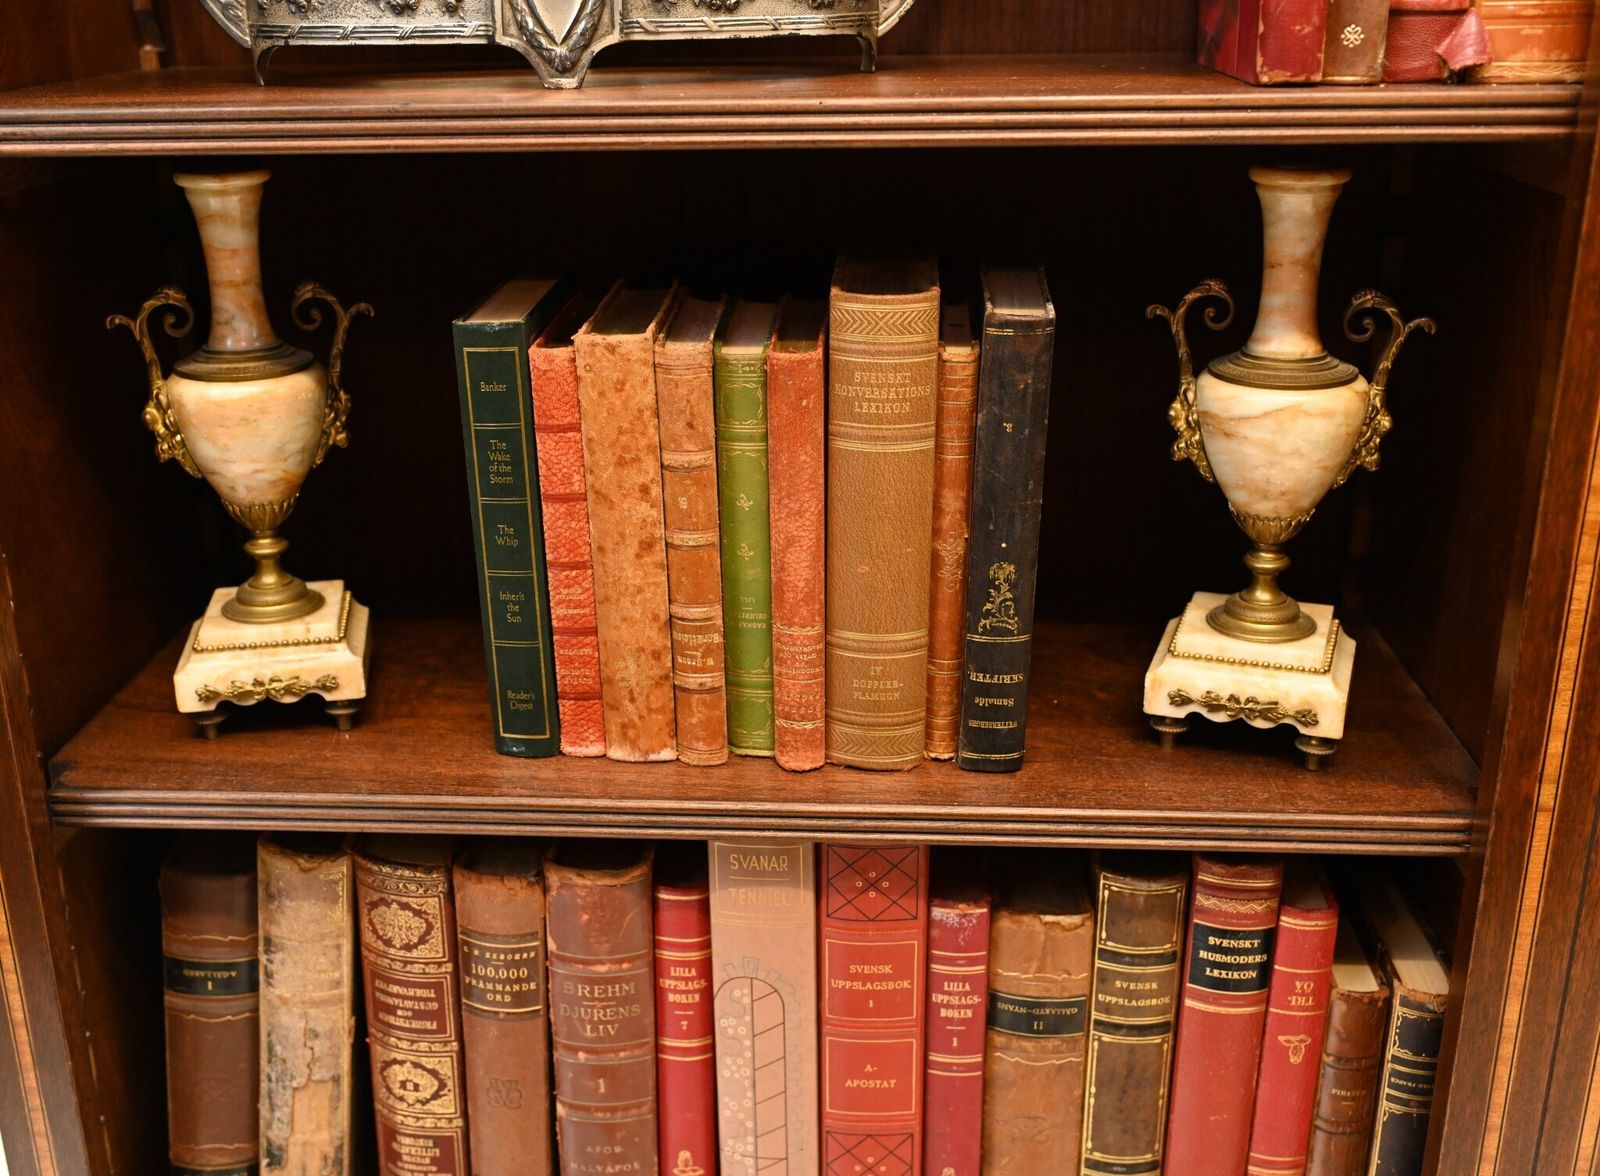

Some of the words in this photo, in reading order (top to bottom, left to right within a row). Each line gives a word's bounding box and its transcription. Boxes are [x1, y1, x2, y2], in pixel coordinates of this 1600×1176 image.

[854, 371, 911, 383] SVENSKT
[480, 381, 507, 392] Banker
[854, 401, 911, 413] LEXIKON
[489, 440, 507, 450] The
[488, 451, 511, 461] Wake
[489, 462, 498, 473] of
[499, 462, 512, 473] the
[490, 474, 514, 484] Storm
[497, 524, 514, 535] The
[495, 536, 519, 547] Whip
[499, 591, 525, 601] Inherit
[507, 602, 520, 612] the
[506, 613, 522, 623] Sun
[870, 666, 882, 676] IV
[853, 679, 904, 689] DOPPLER-
[507, 690, 535, 700] Reader's
[509, 701, 534, 712] Digest
[729, 854, 789, 871] SVANAR
[728, 887, 791, 906] TENNIEL
[1208, 936, 1261, 948] SVENSKT
[1199, 950, 1267, 964] HUSMODERS
[670, 966, 697, 977] LILLA
[849, 964, 893, 974] SVENSK
[1205, 967, 1258, 980] LEXIKON
[563, 981, 636, 998] BREHM
[659, 978, 709, 991] UPPSLAGS-
[830, 978, 912, 991] UPPSLAGSBOK
[944, 981, 971, 992] LILLA
[1115, 980, 1159, 990] SVENSK
[486, 993, 512, 1003] ORD
[668, 992, 700, 1003] BOKEN
[932, 992, 982, 1005] UPPSLAGS-
[1098, 993, 1172, 1007] UPPSLAGSBOK
[559, 1003, 641, 1021] DJURENS
[940, 1008, 973, 1018] BOKEN
[586, 1024, 619, 1037] LIV
[680, 1020, 689, 1030] 7
[864, 1064, 878, 1072] A-
[597, 1077, 606, 1093] 1
[845, 1079, 897, 1088] APOSTAT
